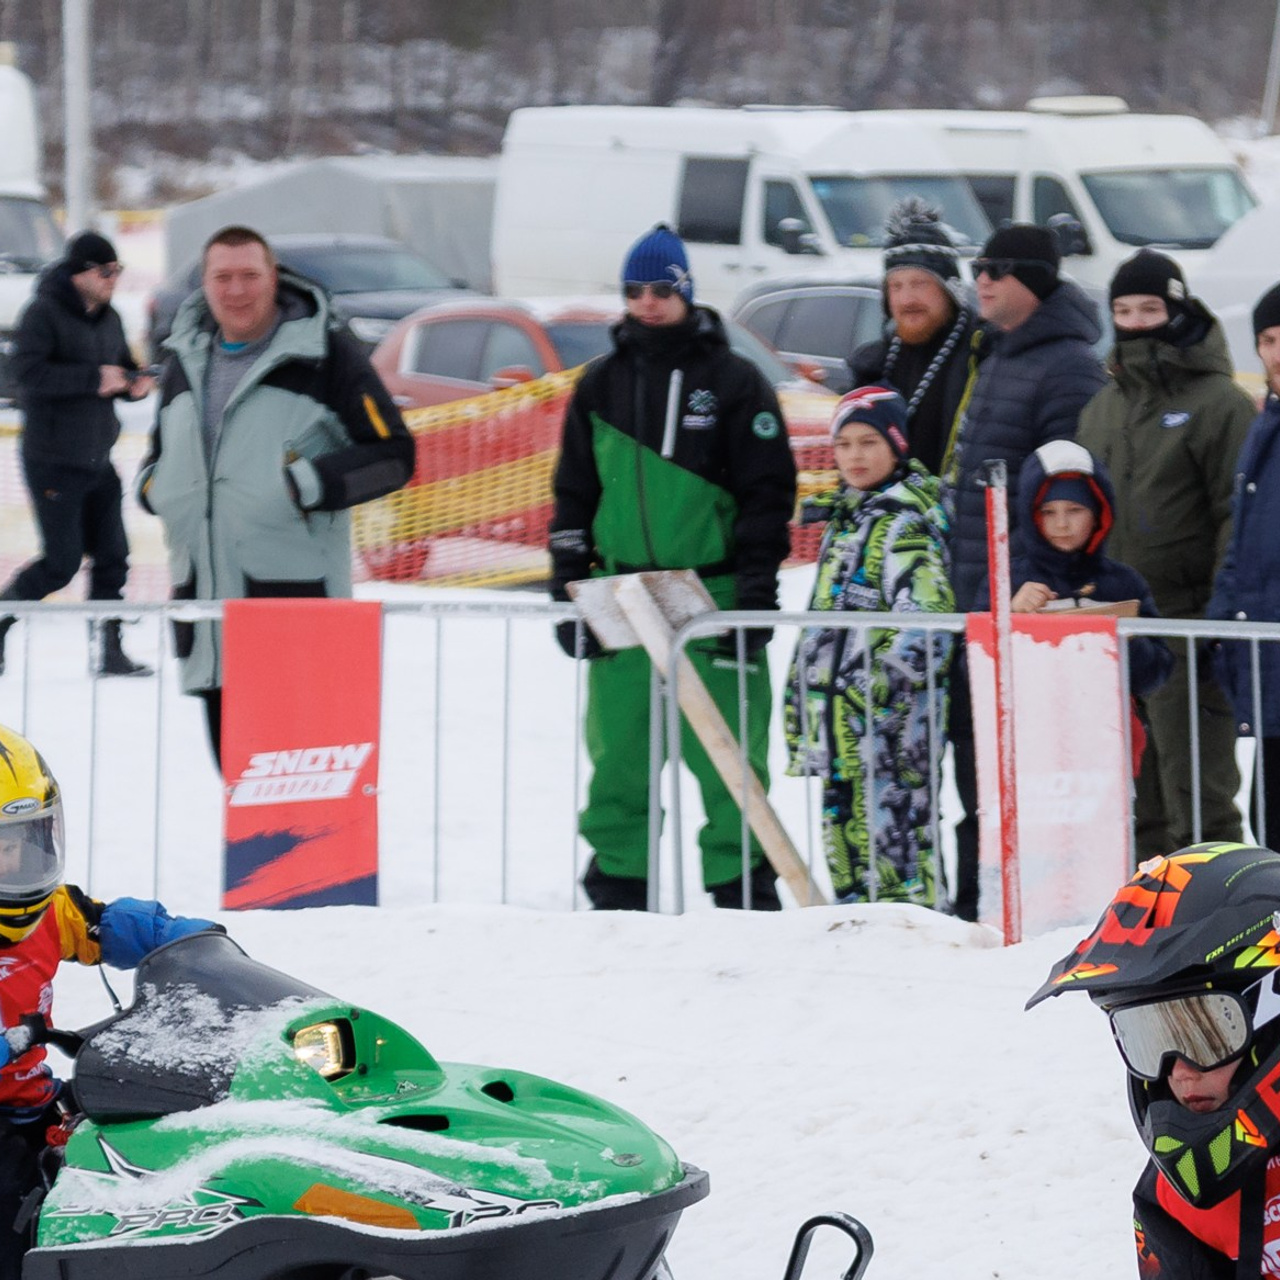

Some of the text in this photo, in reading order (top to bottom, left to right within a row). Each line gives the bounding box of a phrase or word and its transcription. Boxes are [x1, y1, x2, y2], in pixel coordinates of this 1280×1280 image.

[241, 742, 374, 778] SNOW
[1205, 945, 1224, 963] FXR
[111, 1203, 236, 1234] PRO
